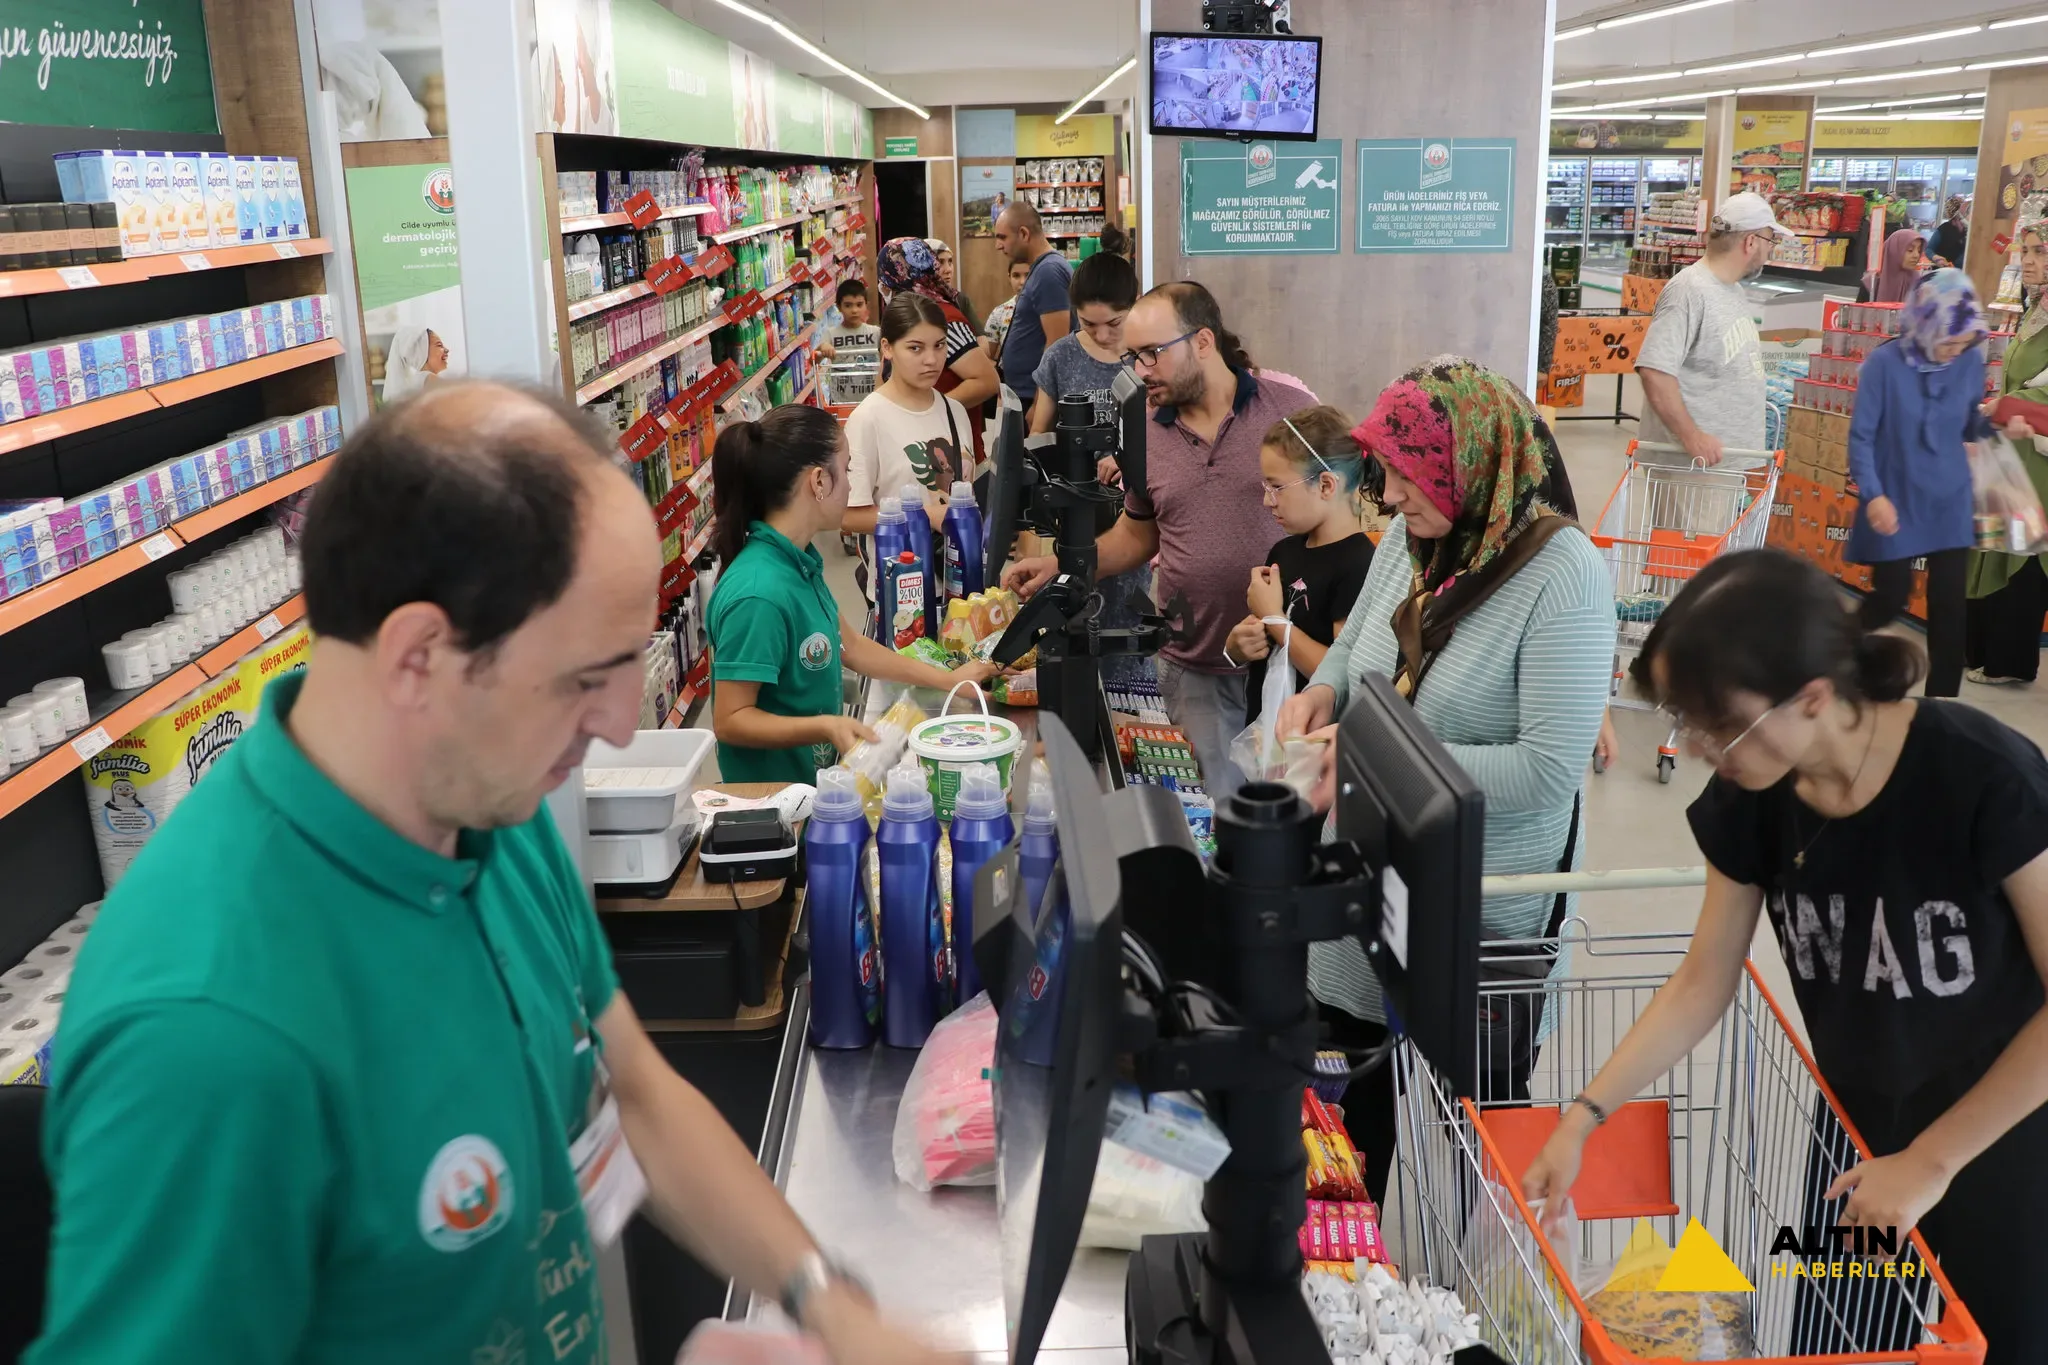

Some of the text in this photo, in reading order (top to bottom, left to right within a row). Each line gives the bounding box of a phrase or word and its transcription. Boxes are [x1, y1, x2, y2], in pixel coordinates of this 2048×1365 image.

[37, 20, 178, 91] güvencesiyiz.
[112, 176, 140, 189] Aptamil
[145, 176, 169, 188] Aptamil
[172, 176, 199, 188] Aptamil
[207, 176, 230, 188] Aptamil
[1216, 195, 1306, 209] SAYIN MÜŞTERİLERİMİZ
[1383, 190, 1488, 202] ÜRÜN İADELERİNİZ FİŞ VEYA
[633, 201, 652, 219] FIRSAT
[1368, 203, 1397, 212] FATURA
[1400, 203, 1409, 212] ile
[1411, 202, 1452, 212] YAPMANIZI
[1453, 201, 1470, 212] RİCA
[1192, 209, 1240, 221] MAĞAZAMIZ
[1286, 208, 1330, 220] GÖRÜLMEZ
[401, 219, 450, 229] Cilde uyumlu
[1211, 220, 1312, 232] GÜVENLİK SİSTEMLERİ ile
[1372, 222, 1391, 230] GENEL
[1423, 221, 1440, 230] GÖRE
[382, 229, 456, 243] dermatolojik
[1225, 232, 1297, 243] KORUNMAKTADIR.
[1388, 230, 1397, 239] FİŞ
[704, 255, 720, 270] FIRSAT
[654, 268, 671, 287] FIRSAT
[730, 302, 743, 317] FIRSAT
[833, 333, 875, 347] BACK
[695, 385, 711, 400] FIRSAT
[676, 398, 692, 416] FIRSAT
[629, 433, 648, 453] FIRSAT
[1771, 503, 1793, 516] FIRSAT
[1826, 527, 1852, 541] FIRSA
[663, 574, 680, 590] FIRSAT
[900, 587, 922, 600] %100
[260, 653, 281, 675] SÜPER
[174, 678, 242, 732] SÜPER EKONOMİK
[91, 754, 150, 780] familia
